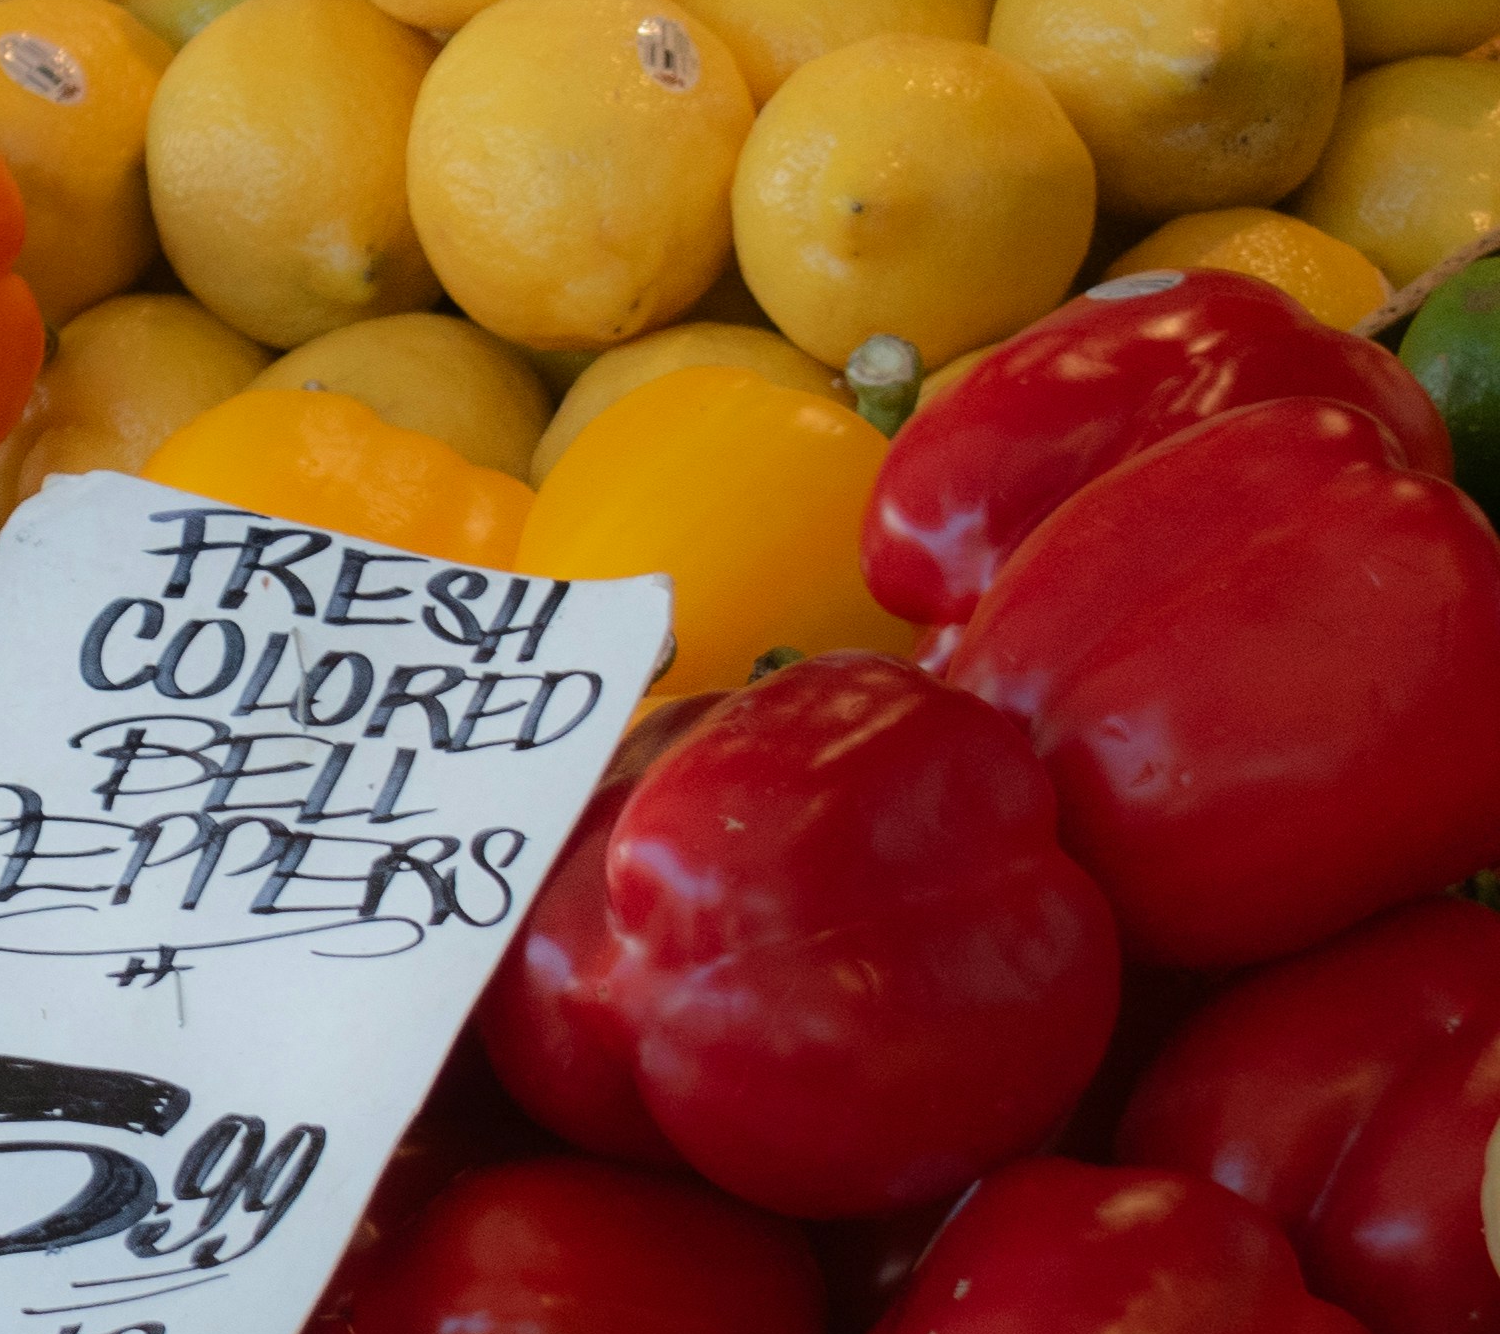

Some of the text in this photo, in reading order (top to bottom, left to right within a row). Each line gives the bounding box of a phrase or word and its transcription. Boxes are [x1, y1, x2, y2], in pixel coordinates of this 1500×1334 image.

[145, 508, 571, 662] FRESH
[78, 597, 604, 753] COLORED
[68, 713, 439, 825] BELL
